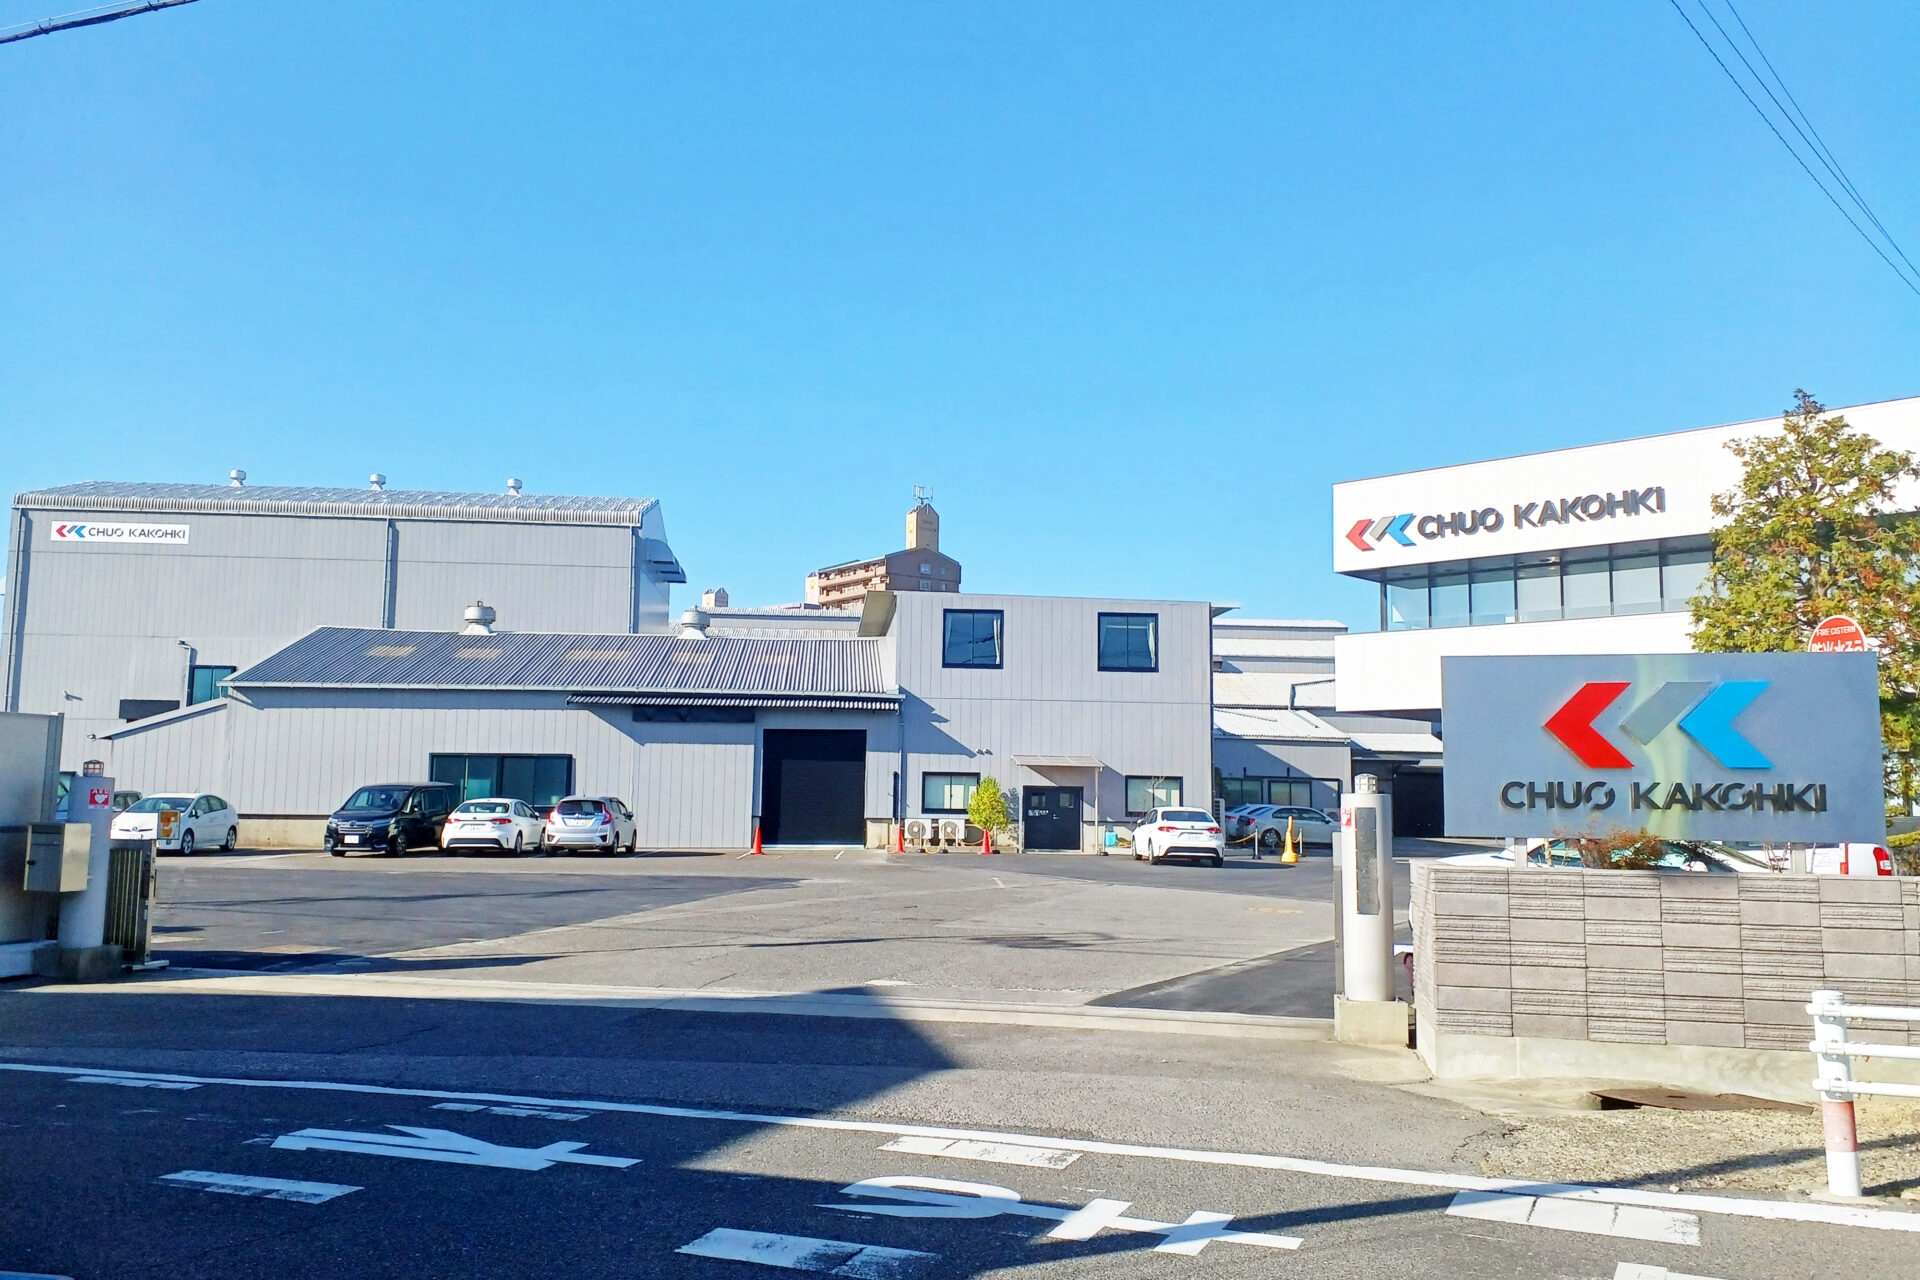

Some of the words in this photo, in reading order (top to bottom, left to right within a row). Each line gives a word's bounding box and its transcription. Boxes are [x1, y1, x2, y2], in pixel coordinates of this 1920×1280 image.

[1417, 507, 1504, 540] CHUO
[1514, 486, 1666, 529] KAKOHKI
[88, 527, 124, 537] CHUO
[128, 528, 186, 539] KAKOHKI
[1816, 628, 1830, 636] FIRE
[1830, 625, 1856, 635] CISTERN
[1501, 781, 1616, 810] CHUO
[1630, 782, 1828, 812] KAKOHKI
